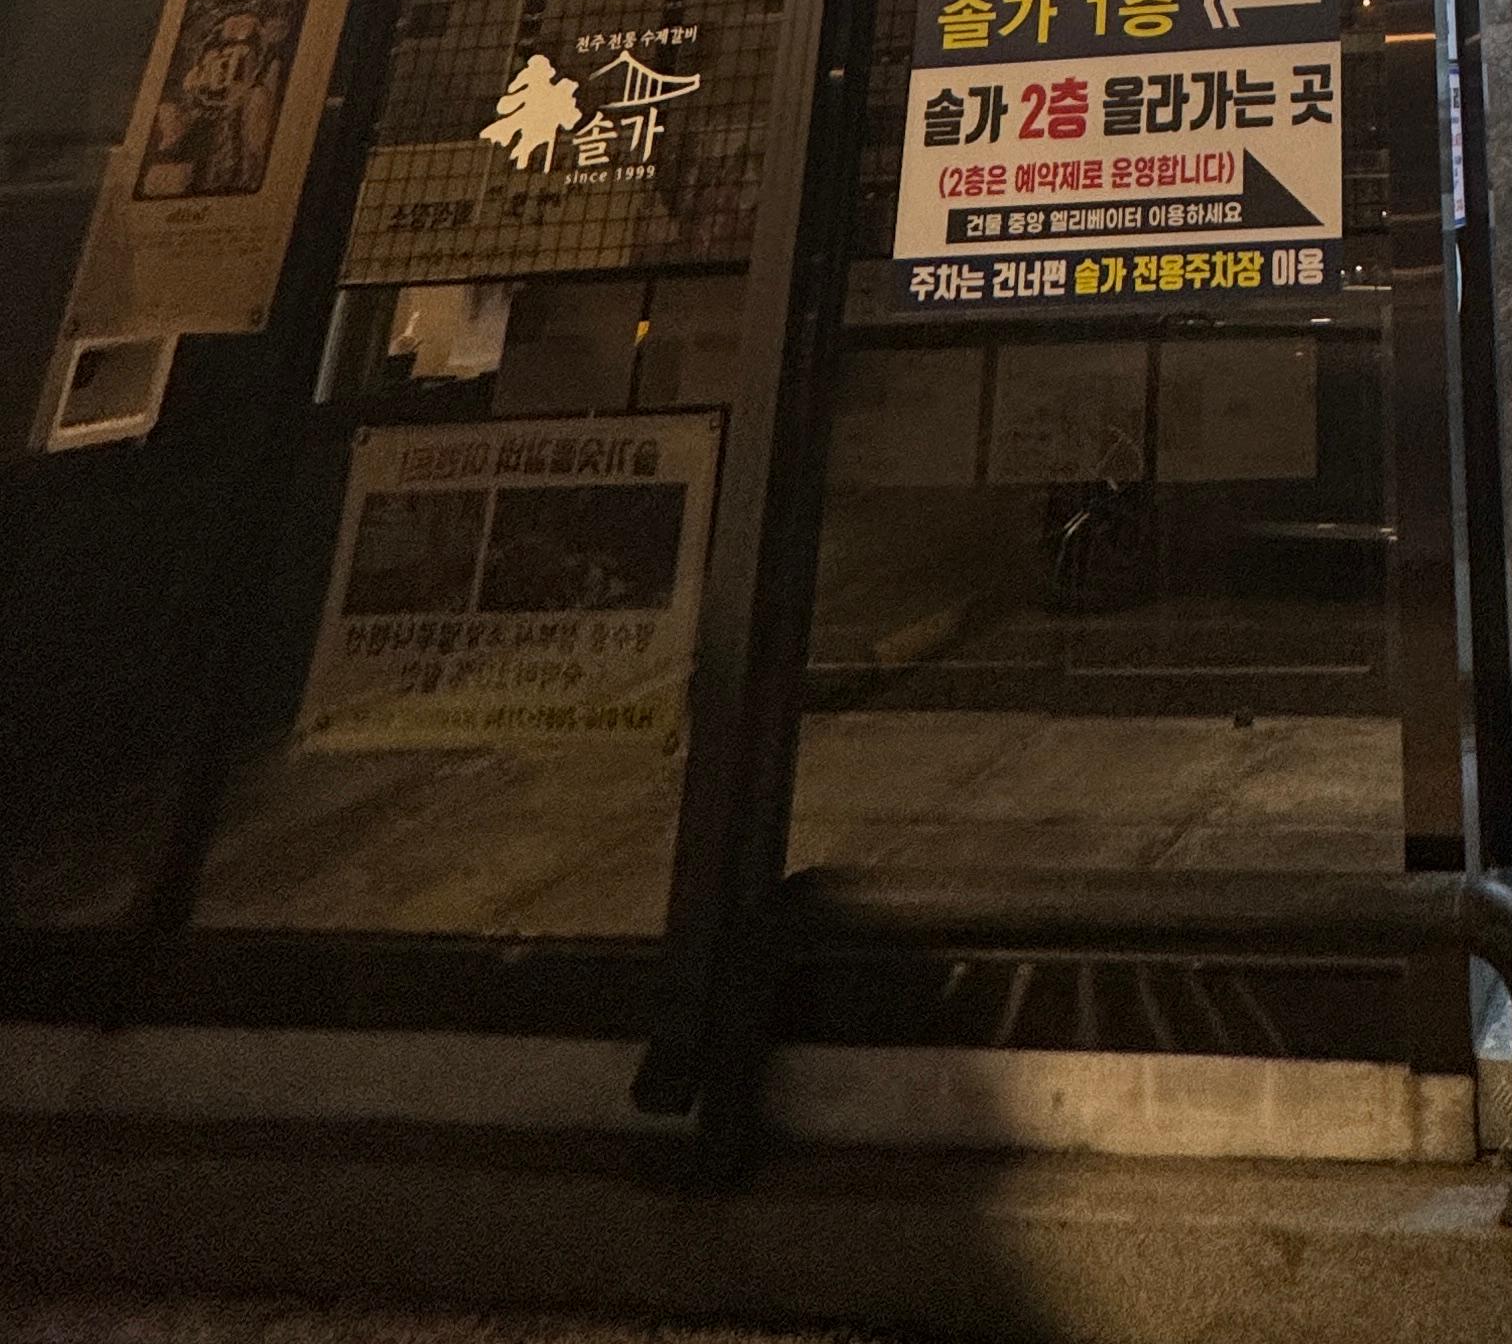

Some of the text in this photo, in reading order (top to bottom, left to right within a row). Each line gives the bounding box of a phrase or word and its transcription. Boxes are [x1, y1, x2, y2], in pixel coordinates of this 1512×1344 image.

[576, 24, 698, 55] 전주 전통 수제갈비
[924, 63, 1334, 147] 솔가 2층 올라가는 곳
[572, 106, 665, 168] 솔가
[564, 165, 657, 186] since 1999
[938, 149, 1236, 200] (2층은 예약제로 운영합니다)
[966, 202, 1243, 238] 건물 중앙 엘리베이터 이용하세요
[909, 247, 1325, 303] 주차는 건너편 솔가 전용주차장 이용
